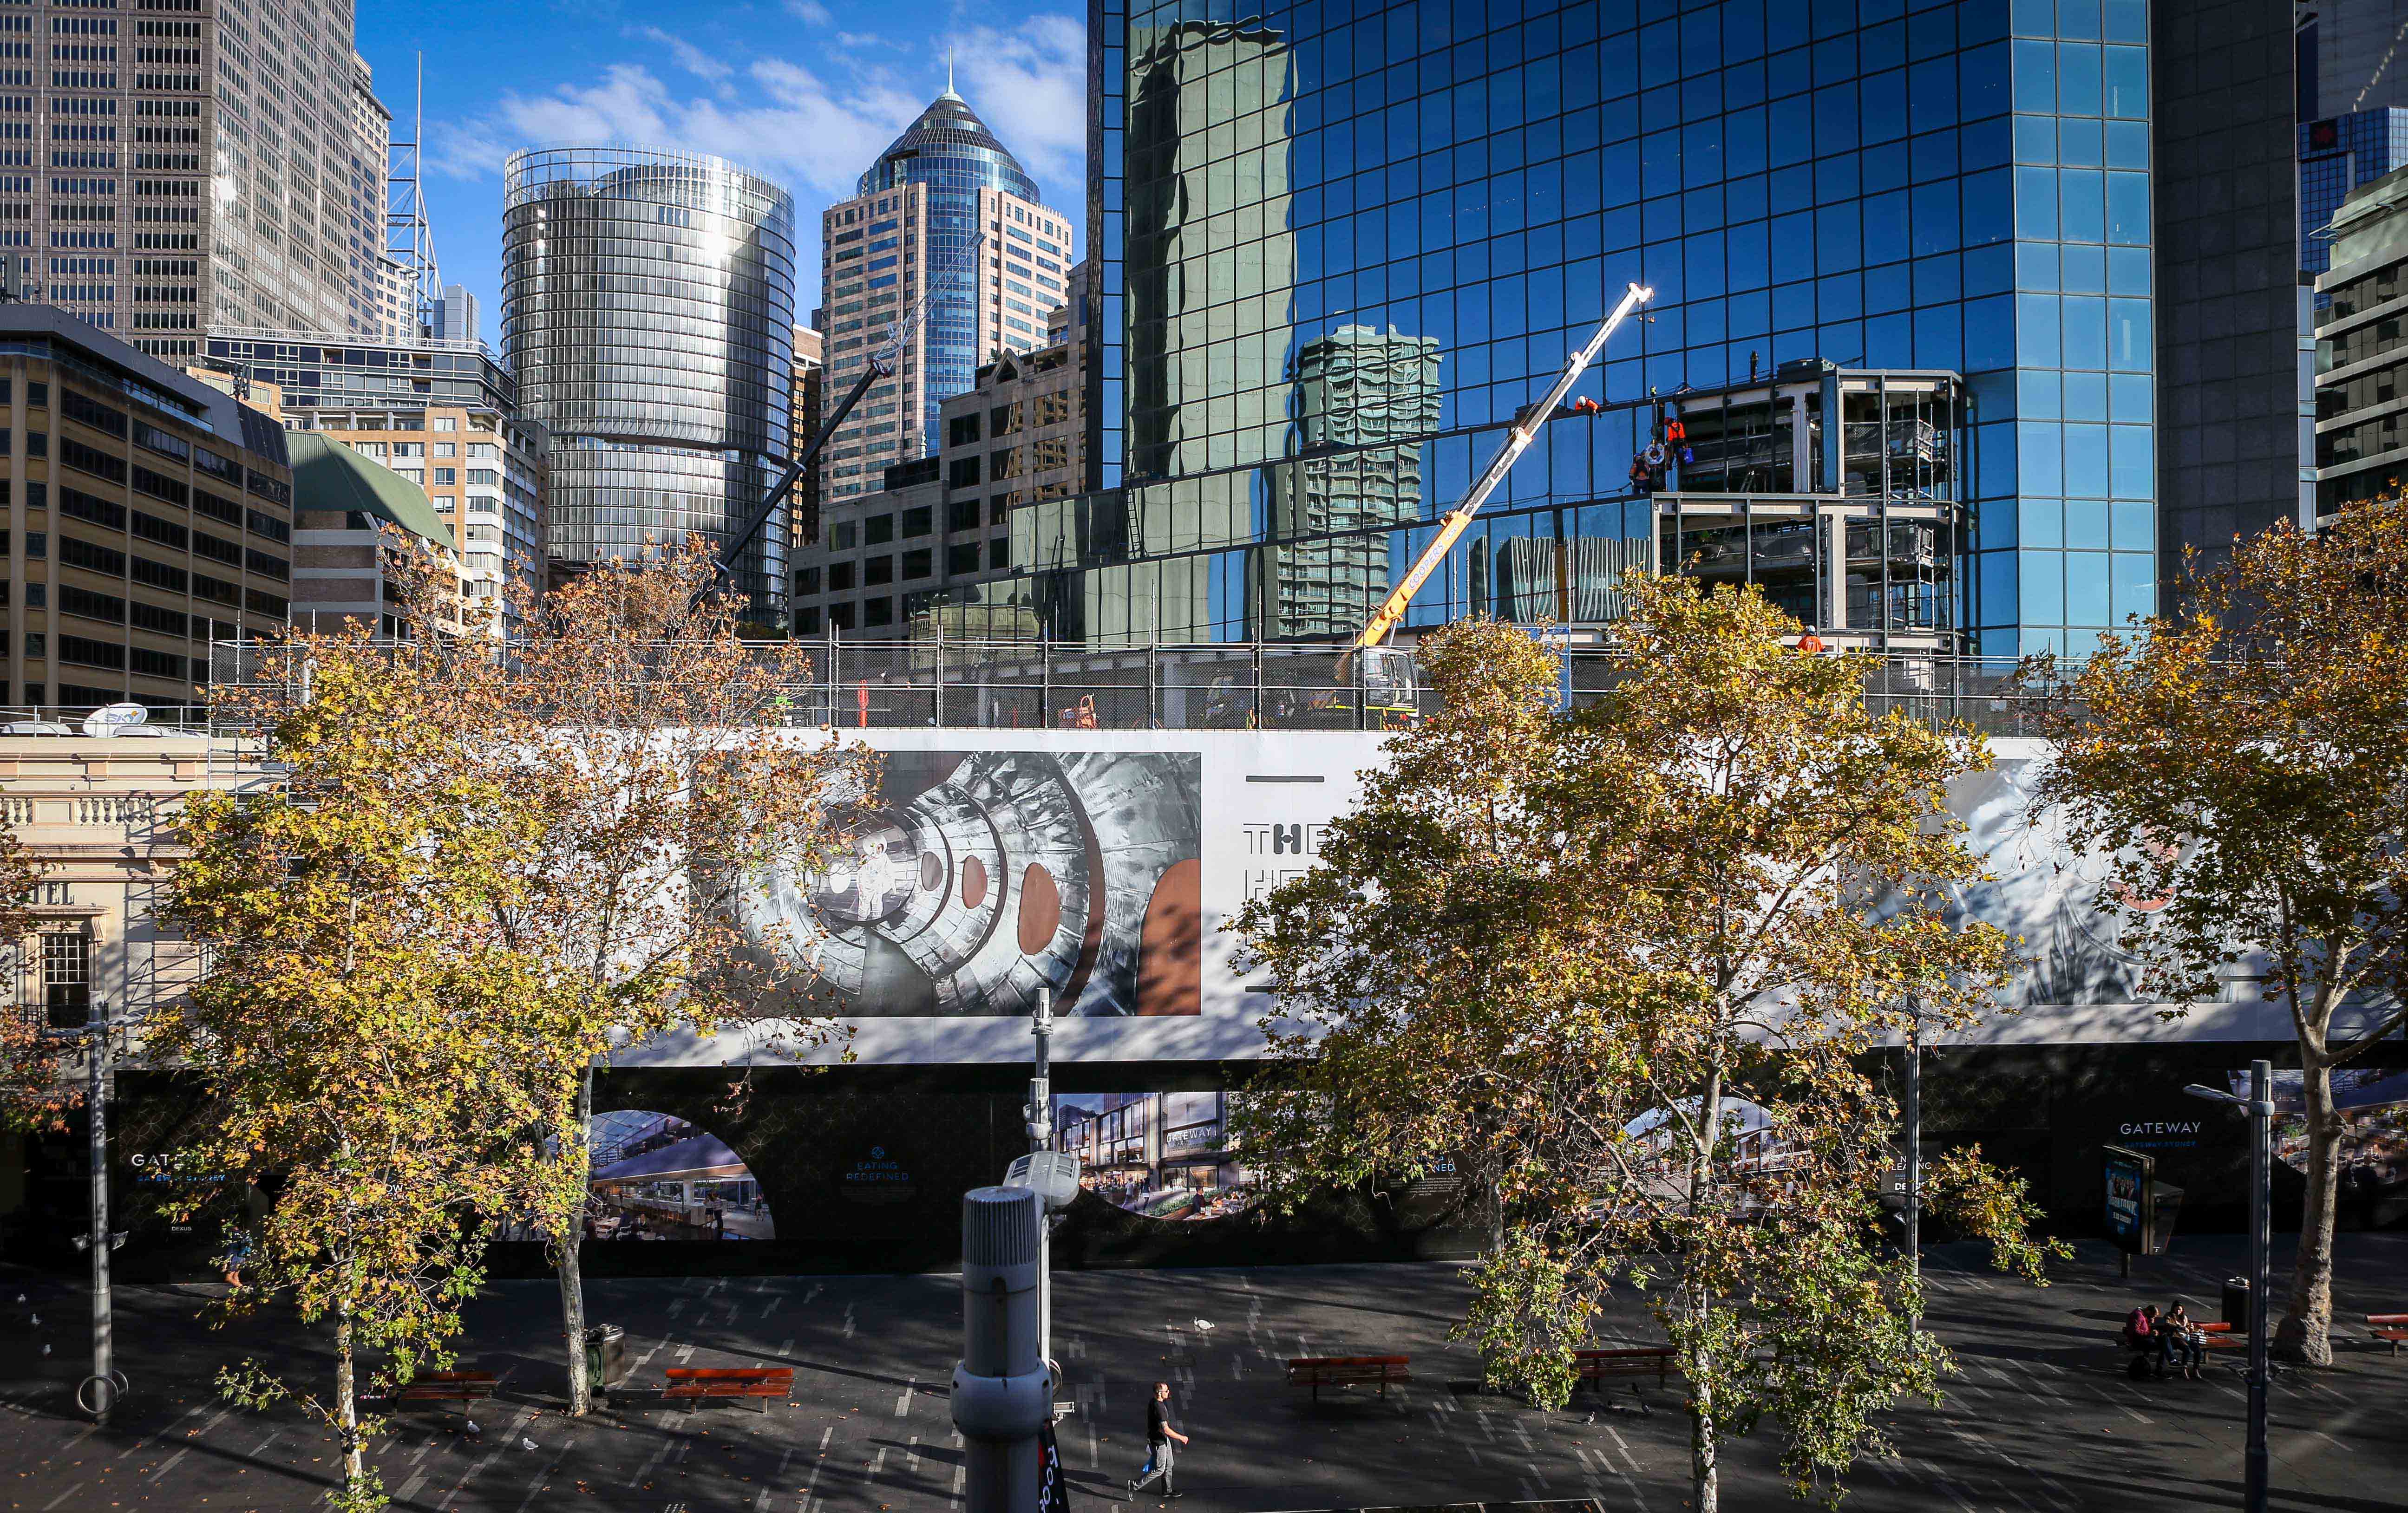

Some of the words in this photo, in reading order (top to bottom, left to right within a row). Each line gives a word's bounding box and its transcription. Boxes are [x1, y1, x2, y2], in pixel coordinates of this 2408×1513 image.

[1409, 541, 1444, 590] COOPERS
[1243, 823, 1332, 854] THE
[2120, 1122, 2201, 1135] GATEWAY
[857, 1161, 897, 1170] EATING
[846, 1173, 909, 1181] REDEFINED
